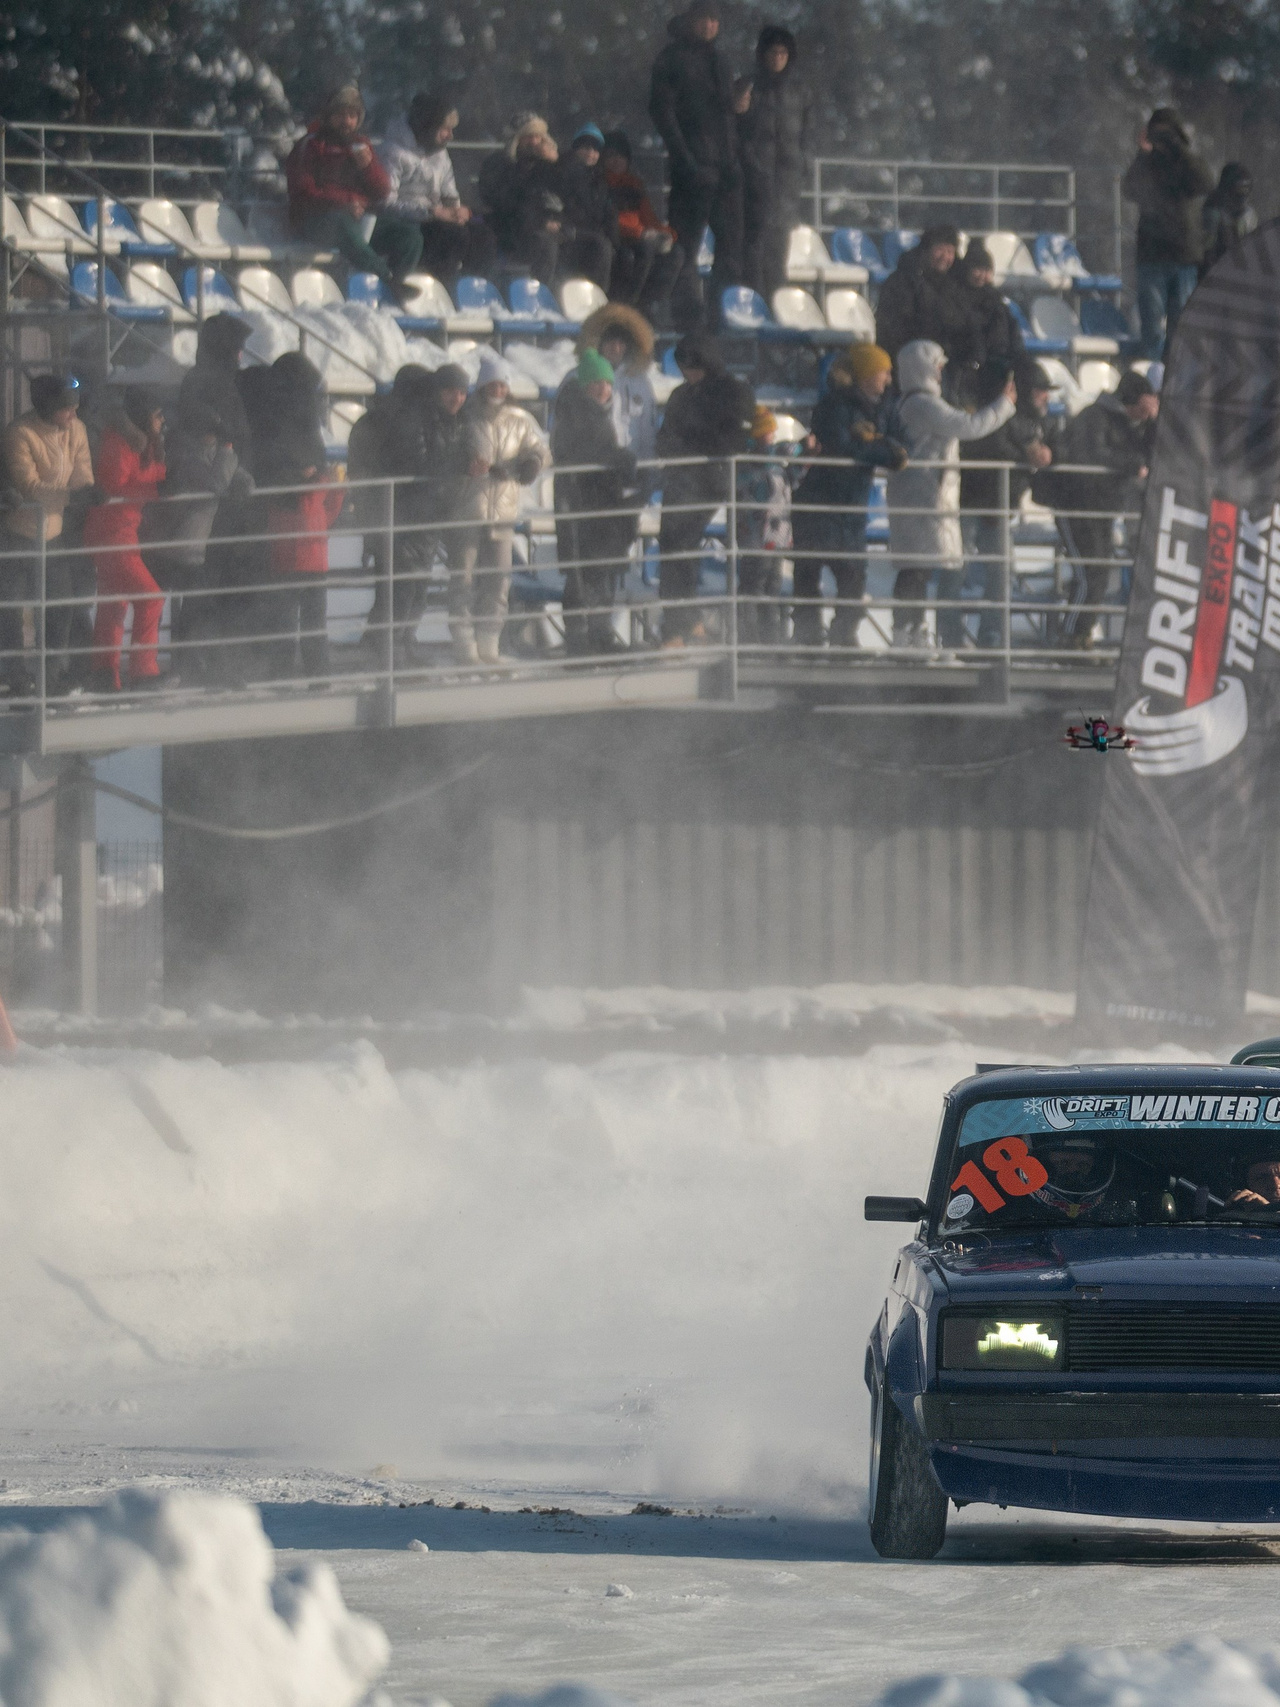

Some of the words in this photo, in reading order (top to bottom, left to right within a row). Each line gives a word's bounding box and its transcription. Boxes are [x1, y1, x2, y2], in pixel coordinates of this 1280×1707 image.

[1141, 486, 1209, 698] DRIFT
[1204, 520, 1233, 605] EXPO
[1224, 508, 1272, 672] TRACK
[1066, 1099, 1127, 1113] DRIFT
[1129, 1095, 1260, 1121] WINTER
[950, 1136, 1049, 1214] 18
